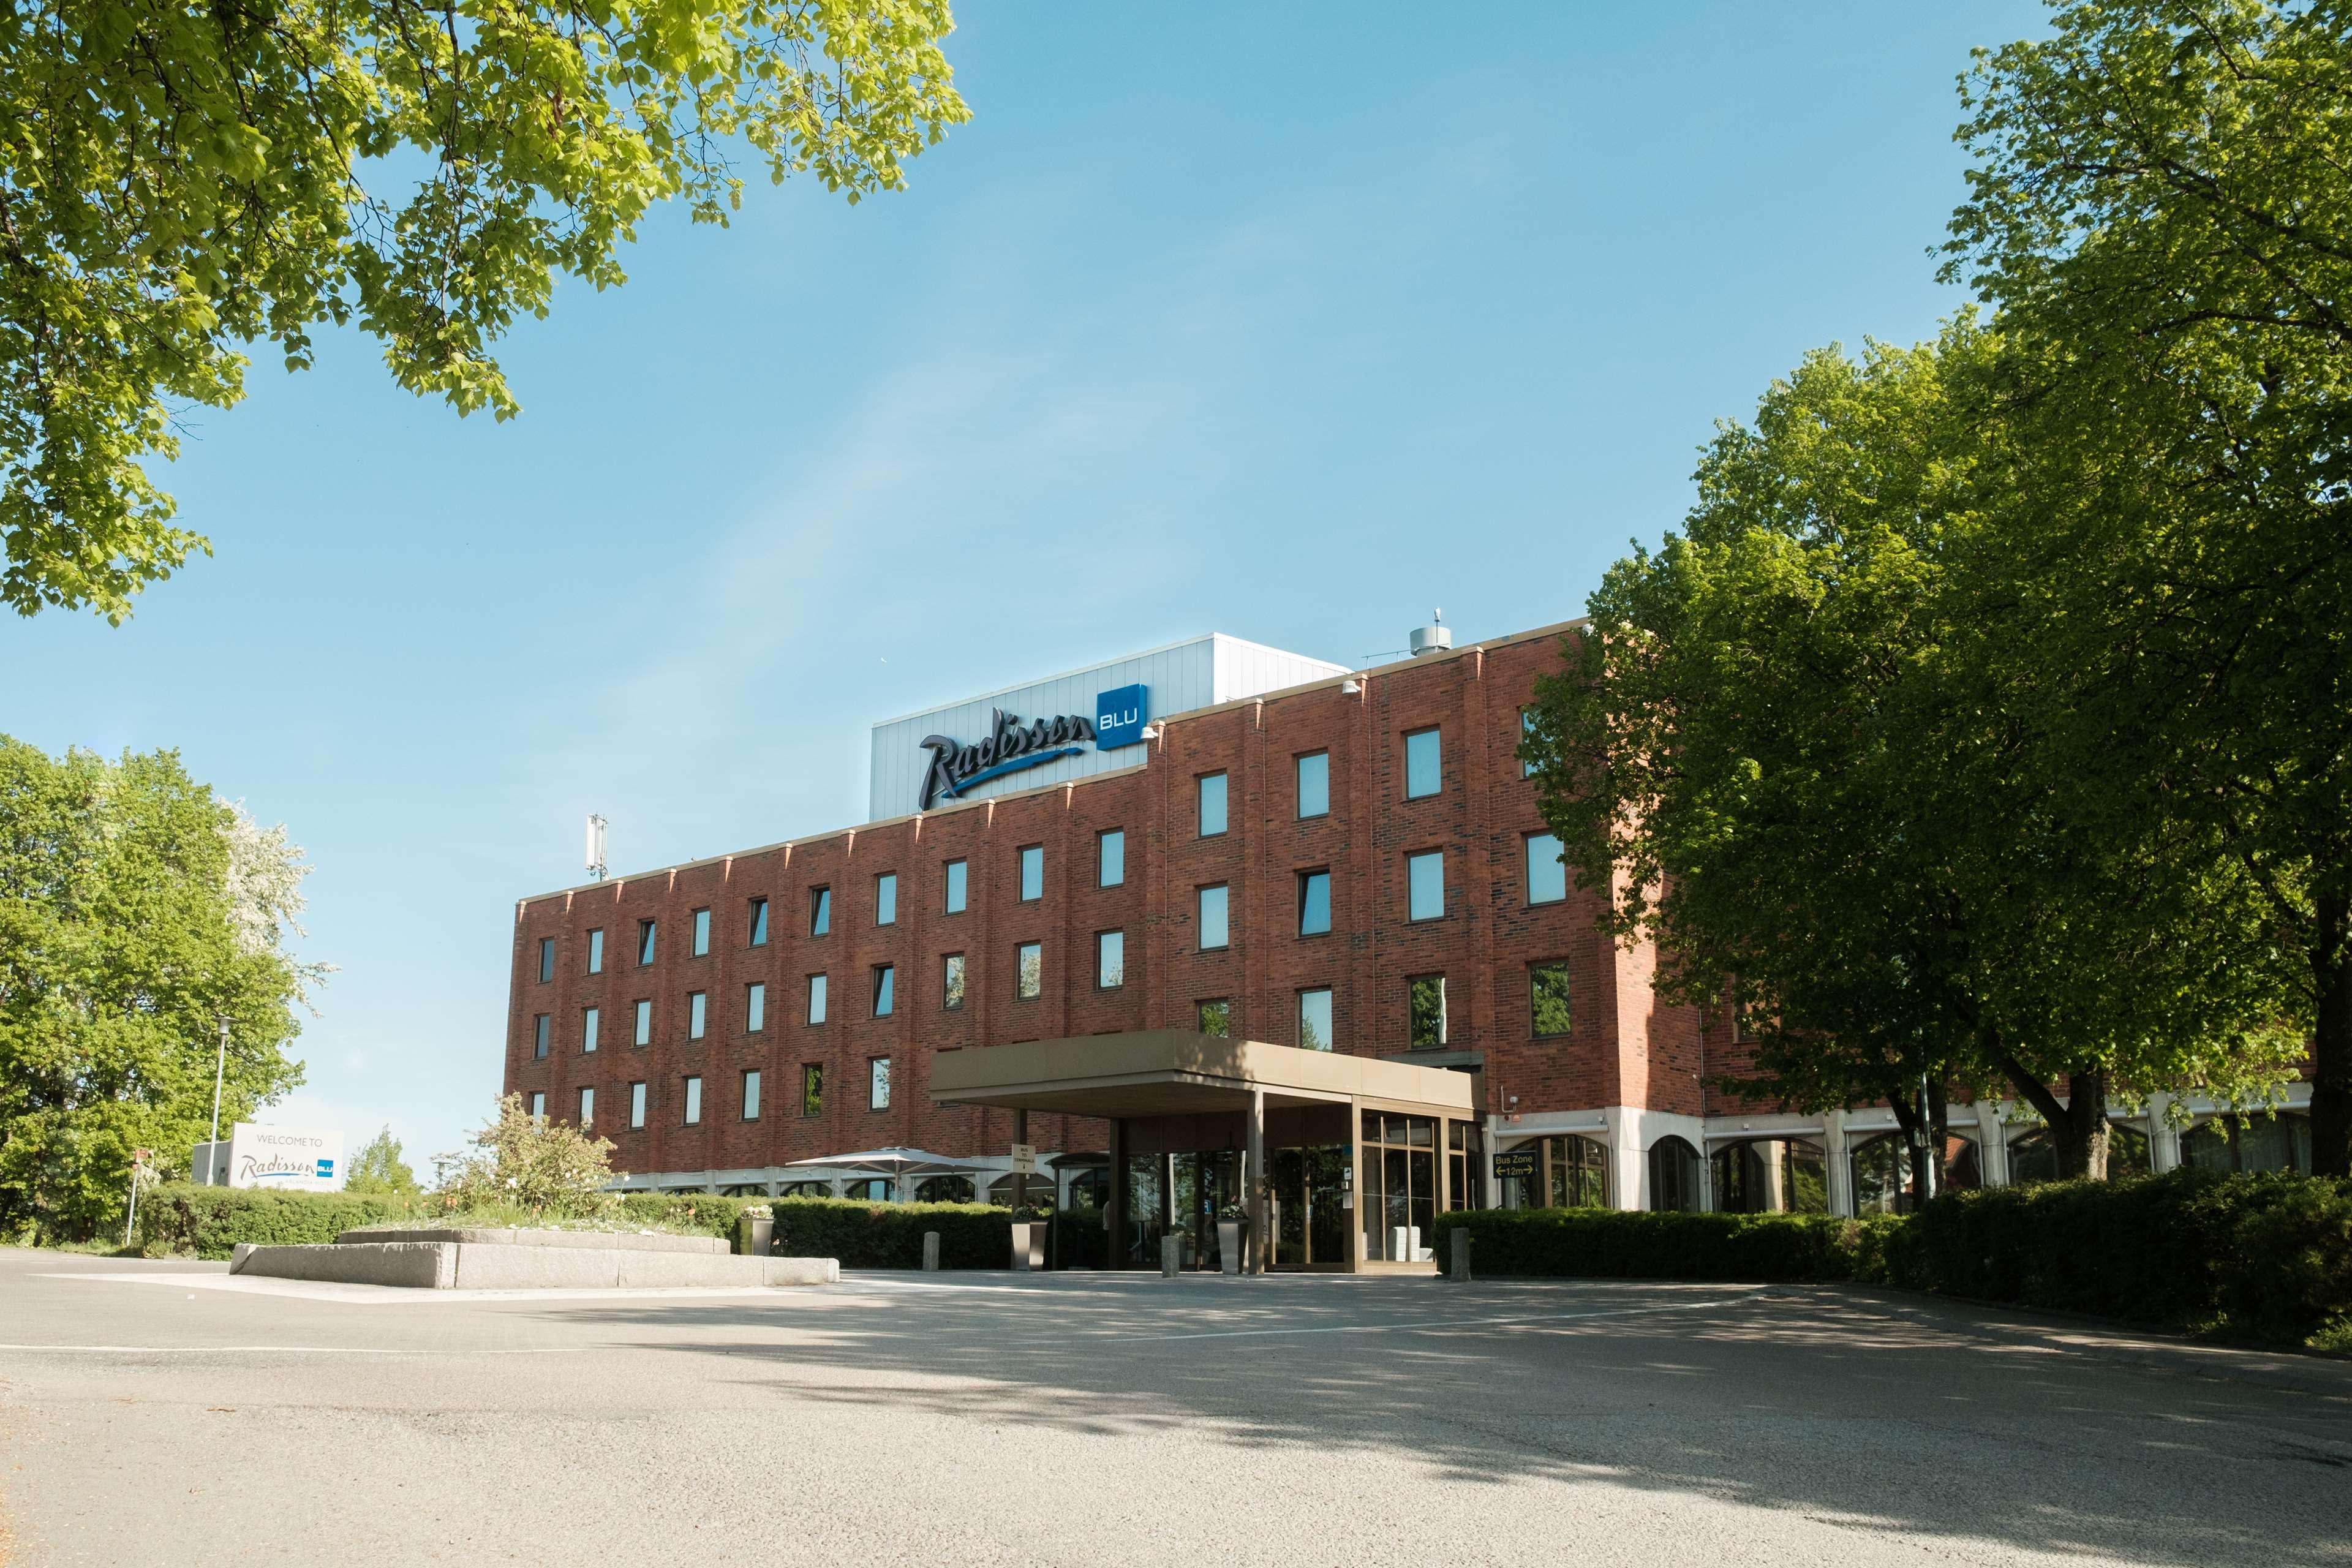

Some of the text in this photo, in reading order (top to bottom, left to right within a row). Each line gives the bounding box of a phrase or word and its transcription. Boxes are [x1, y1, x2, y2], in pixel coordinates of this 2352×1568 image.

[919, 707, 1137, 811] Radisson BLU
[257, 1134, 323, 1147] WELCOME TO
[1495, 1155, 1533, 1164] Bus Zone
[240, 1153, 314, 1181] Radisson
[1506, 1166, 1523, 1175] 12m
